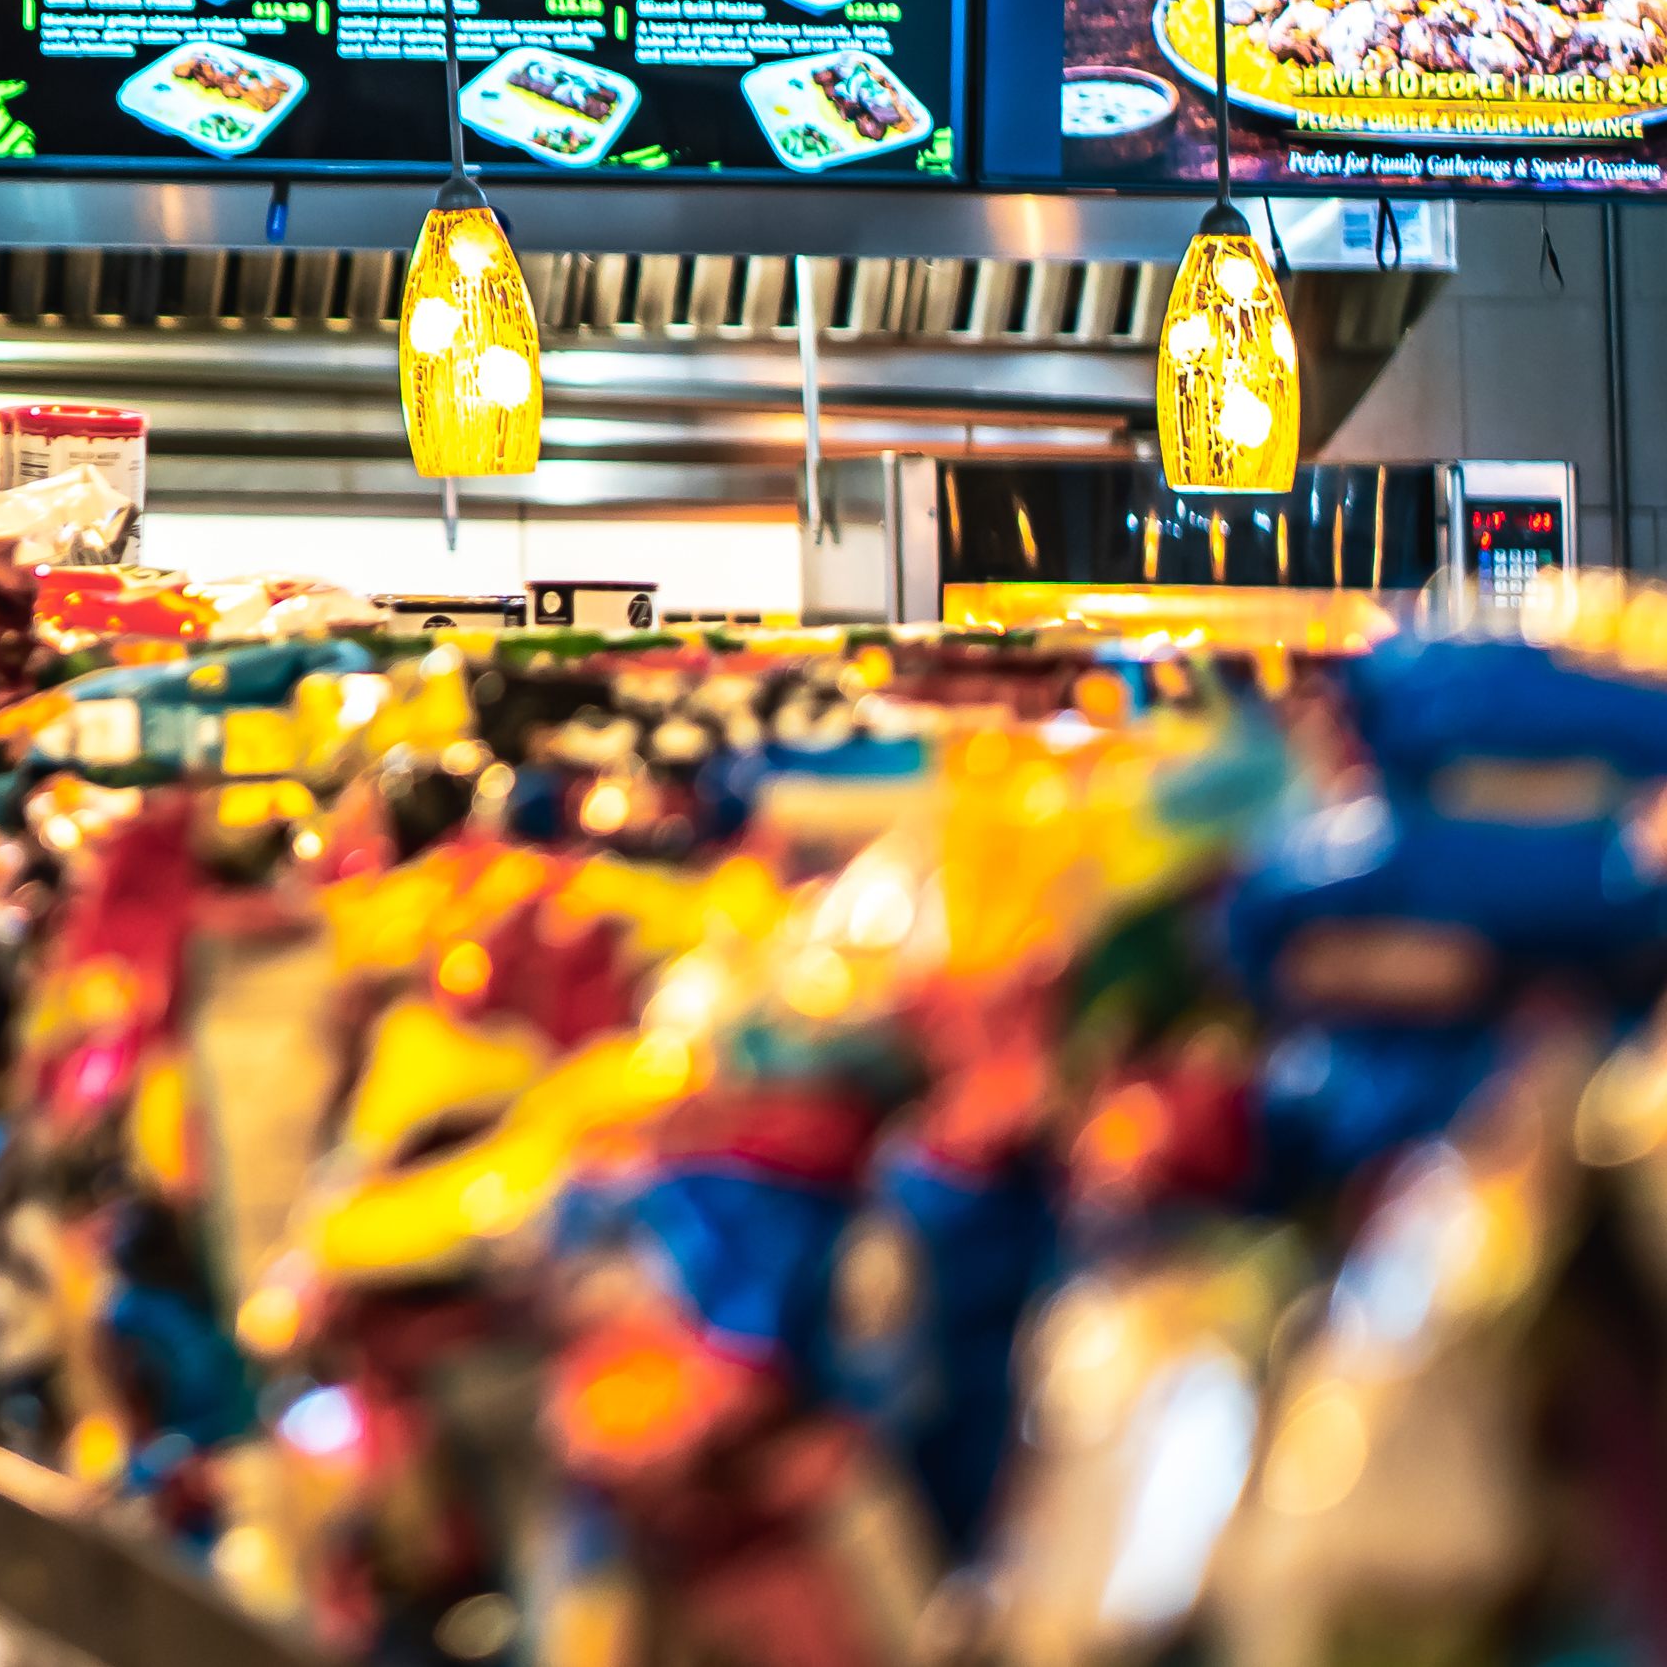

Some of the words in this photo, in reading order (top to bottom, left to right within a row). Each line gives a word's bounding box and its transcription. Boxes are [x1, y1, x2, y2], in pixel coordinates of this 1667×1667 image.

[1288, 69, 1383, 96] SERVES
[1386, 70, 1417, 97] 10
[1421, 72, 1505, 100] PEOPLE
[1295, 110, 1363, 131] PLEASE
[1367, 112, 1432, 132] ORDER
[1455, 114, 1522, 134] HOURS
[1528, 116, 1549, 136] IN
[1553, 117, 1644, 139] ADVANCE
[1289, 150, 1342, 176] Perfect
[1344, 151, 1368, 177] for
[1372, 153, 1423, 178] Family
[1427, 154, 1512, 181] Gatherings
[1531, 157, 1585, 182] Special
[1588, 158, 1662, 181] Occasions
